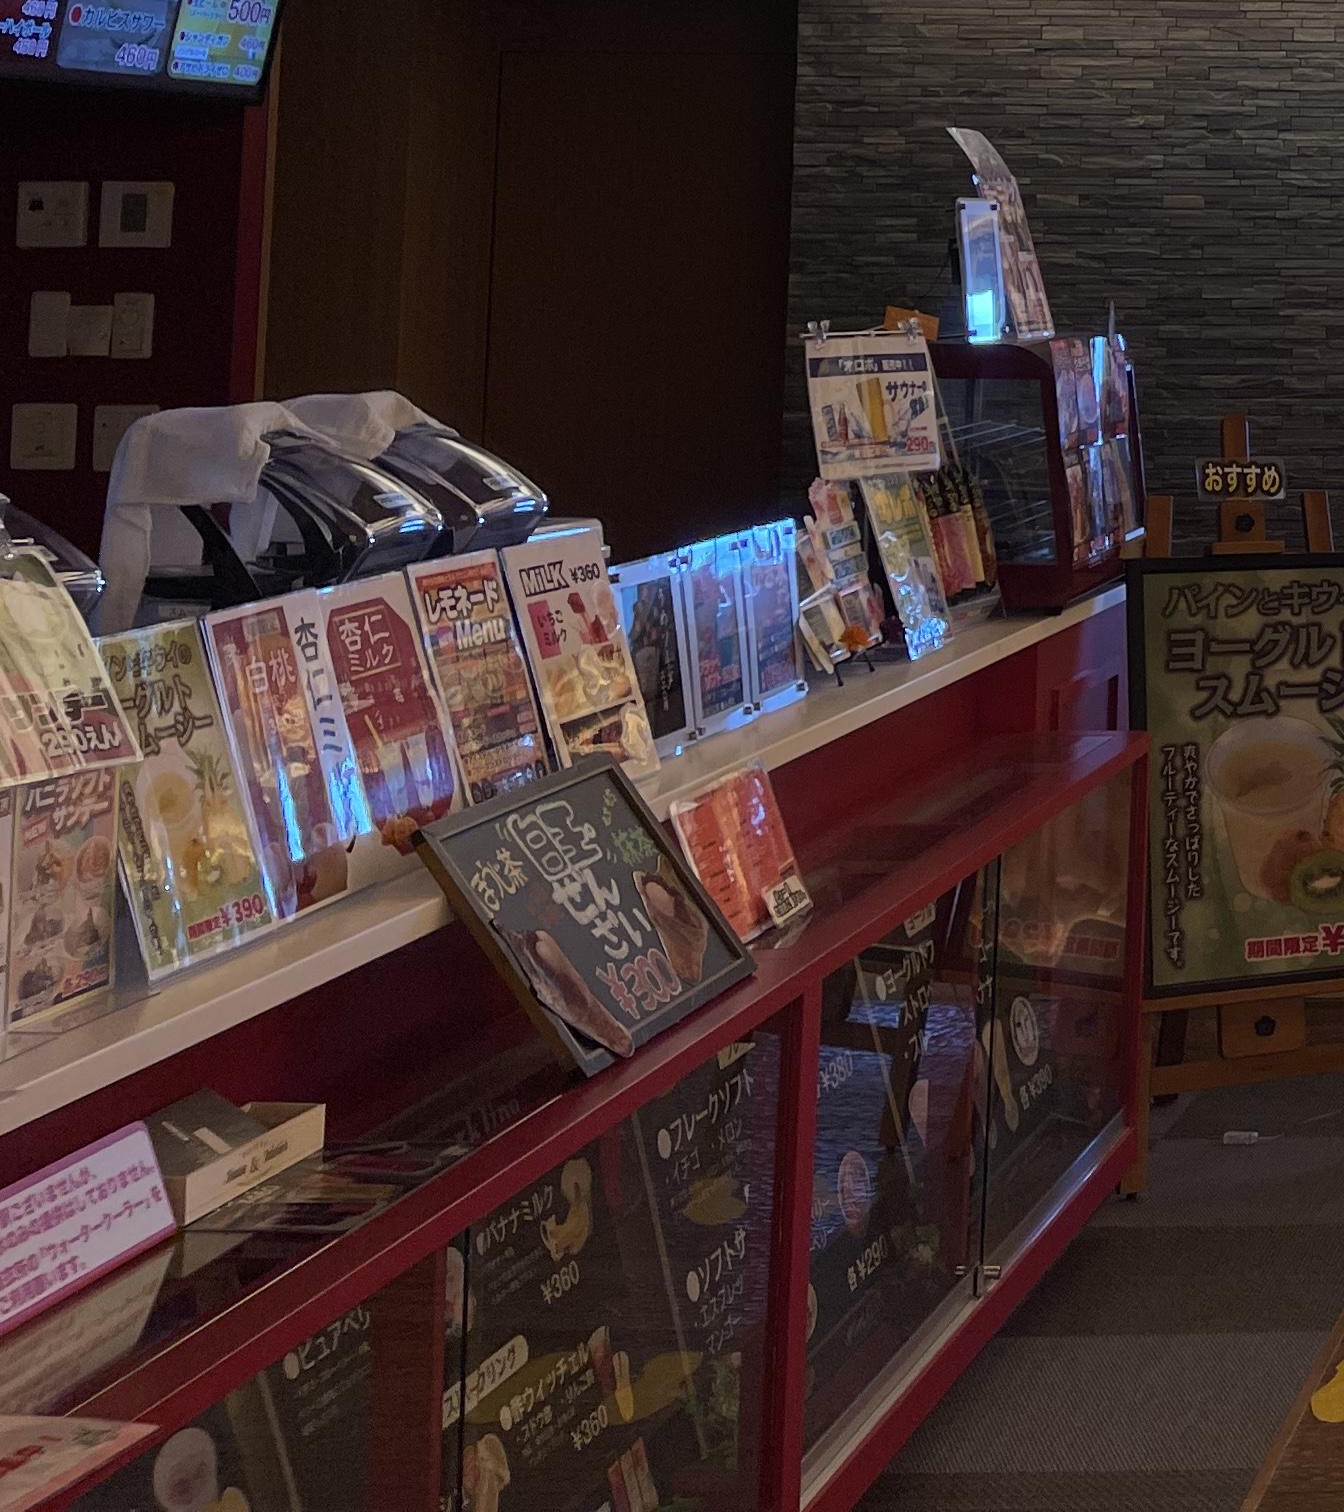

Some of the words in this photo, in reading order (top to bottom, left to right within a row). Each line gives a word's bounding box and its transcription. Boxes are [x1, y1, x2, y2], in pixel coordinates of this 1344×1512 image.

[84, 7, 166, 34] カルピスサワー
[115, 44, 159, 71] 460円
[1202, 462, 1281, 495] おすすめ
[423, 577, 500, 624] レモネード
[338, 614, 390, 653] 杏仁
[454, 616, 506, 651] Menu
[244, 646, 297, 694] 白桃
[349, 644, 394, 673] ミルク
[1246, 935, 1319, 959] 期間限定
